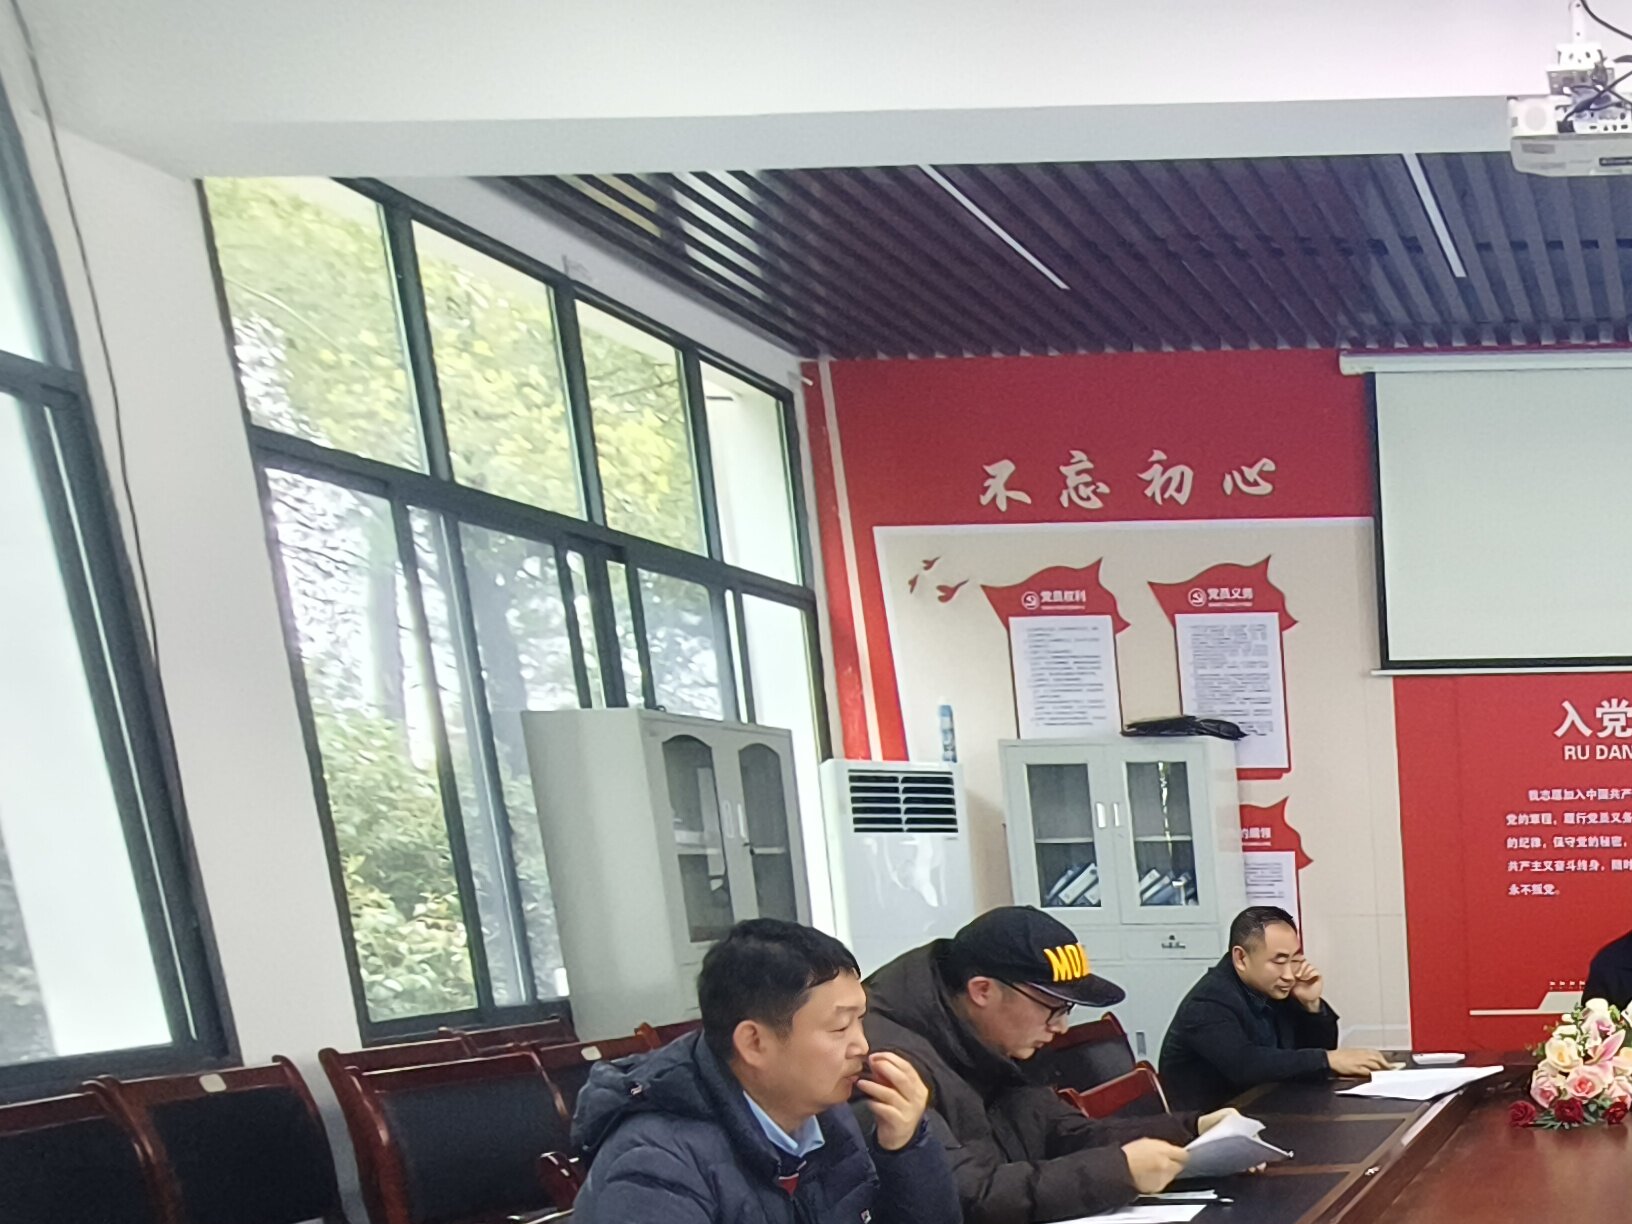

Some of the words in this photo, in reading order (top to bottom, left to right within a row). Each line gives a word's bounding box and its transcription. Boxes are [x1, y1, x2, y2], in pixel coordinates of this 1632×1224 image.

[979, 449, 1277, 512] 不忘初心
[1564, 745, 1590, 761] RU
